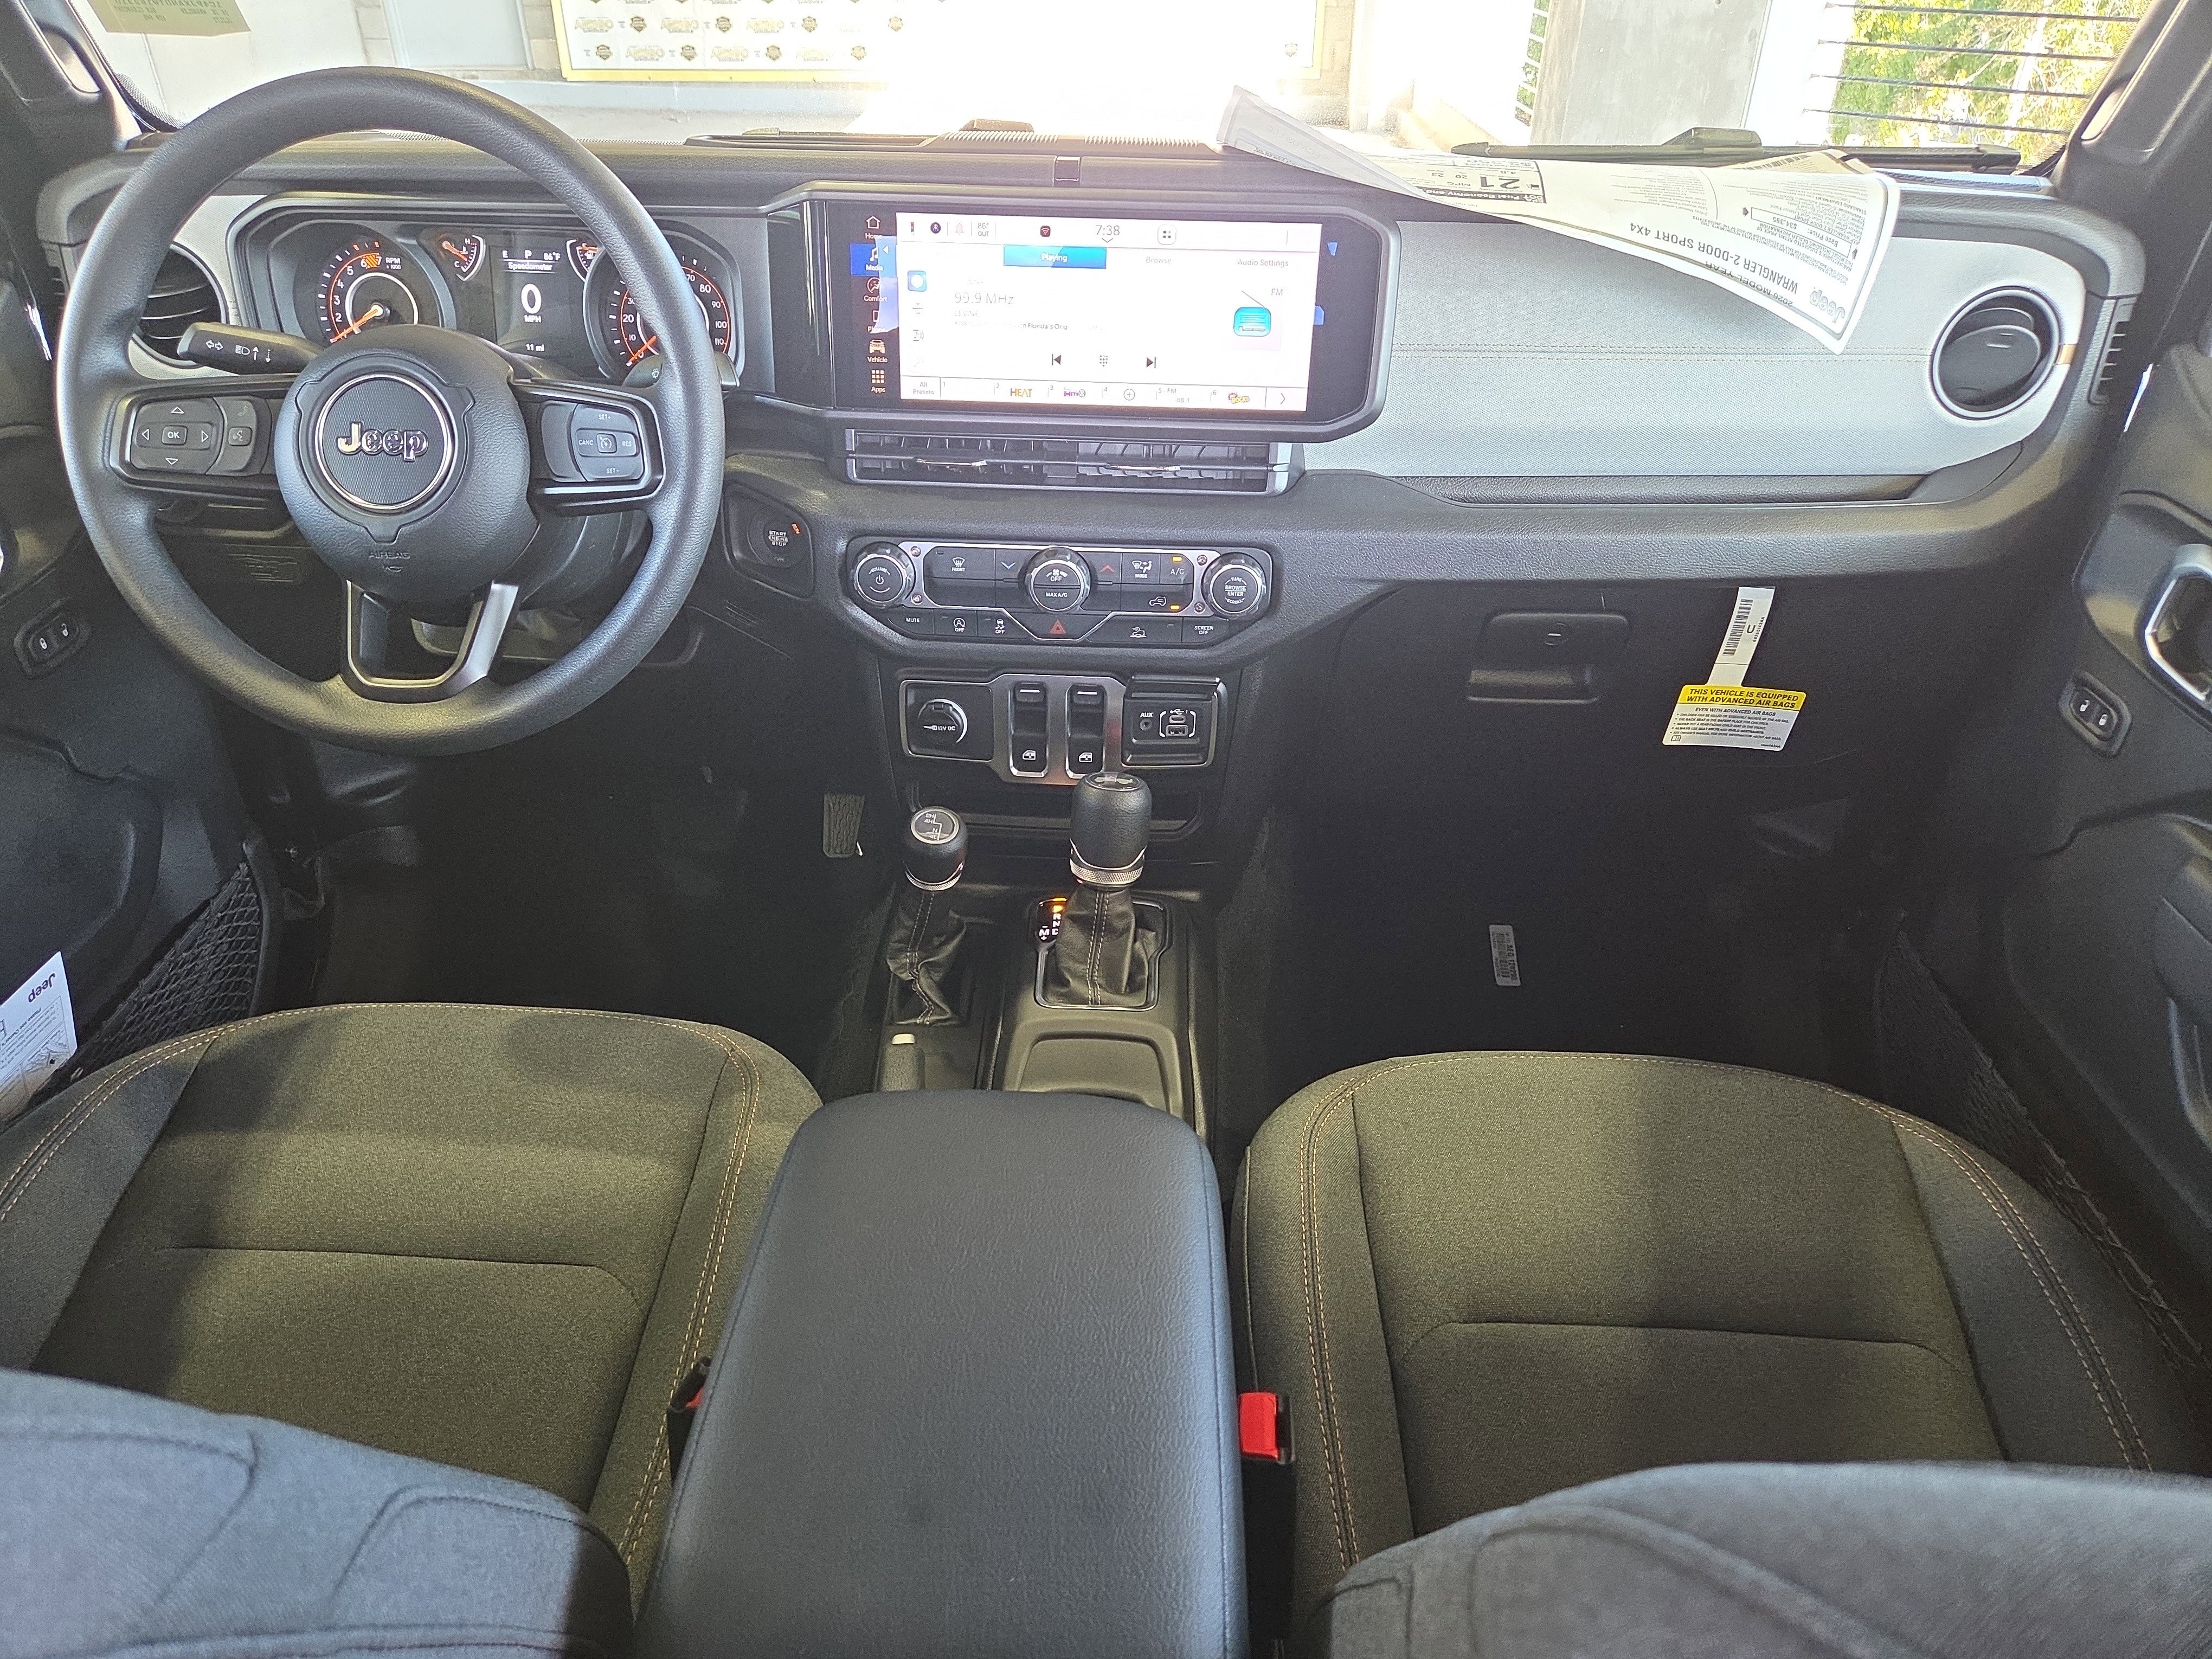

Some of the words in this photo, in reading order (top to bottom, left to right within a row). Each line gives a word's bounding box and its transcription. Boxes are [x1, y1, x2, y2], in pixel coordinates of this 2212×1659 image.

[1480, 176, 1520, 189] 21
[1447, 190, 1492, 198] Economy
[1772, 216, 1797, 229] $34,395
[1096, 225, 1120, 236] 7:38
[1630, 222, 1651, 237] 4X4
[1808, 228, 1824, 240] Price:
[1654, 229, 1694, 249] SPORT
[1825, 237, 1838, 247] Base
[524, 250, 532, 259] P
[543, 252, 561, 261] 86°F
[1041, 252, 1068, 263] Playing
[1698, 241, 1740, 266] 2-DOOR
[361, 258, 366, 268] 6
[376, 256, 382, 265] 7
[1260, 259, 1288, 268] Settings
[347, 266, 353, 275] 5
[508, 262, 553, 271] Speedometer
[1705, 261, 1733, 276] YEAR
[1744, 258, 1798, 294] WRANGLER
[337, 279, 344, 288] 4
[1737, 272, 1771, 296] MODEL
[699, 285, 711, 293] 80
[334, 295, 340, 305] 3
[521, 284, 542, 314] 0
[955, 292, 981, 304] 99.9
[986, 293, 1014, 305] MHz
[1773, 291, 1793, 307] 2026
[1809, 289, 1846, 324] Jeep
[335, 313, 342, 322] 2
[623, 314, 634, 323] 20
[1010, 388, 1033, 397] HEAT
[168, 431, 180, 439] OK
[337, 421, 428, 461] Jeep
[1746, 624, 1756, 633] U
[1756, 692, 1799, 701] EQUIPPED
[28, 973, 56, 1003] Jeep
